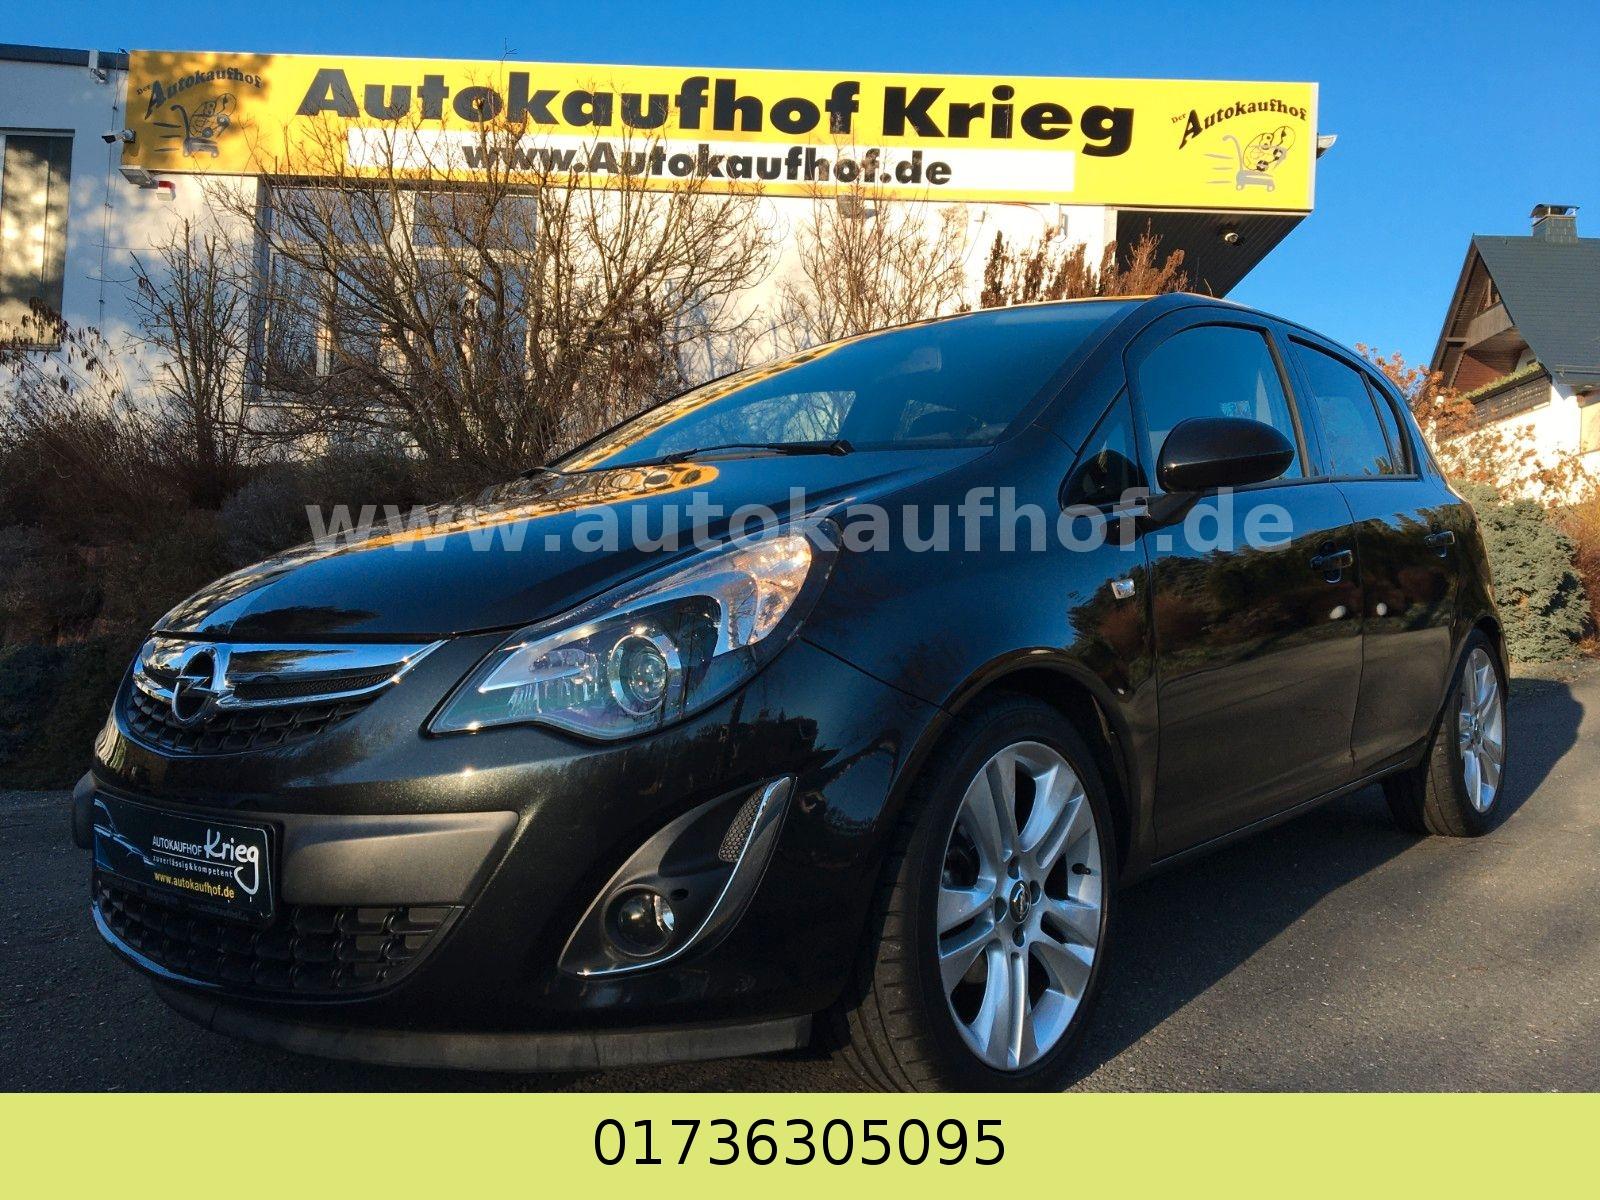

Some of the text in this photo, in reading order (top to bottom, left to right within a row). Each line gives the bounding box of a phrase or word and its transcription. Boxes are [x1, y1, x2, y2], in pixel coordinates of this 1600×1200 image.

[145, 67, 263, 120] Autokaufhof
[297, 68, 1135, 157] Autokaufhof Krieg
[1171, 98, 1307, 150] Der Autokaufhof
[463, 141, 952, 186] www.Autokaufhof.de
[152, 828, 259, 895] AUTOKAUFHOF Krieg
[153, 871, 235, 899] www.autokaufhof.de
